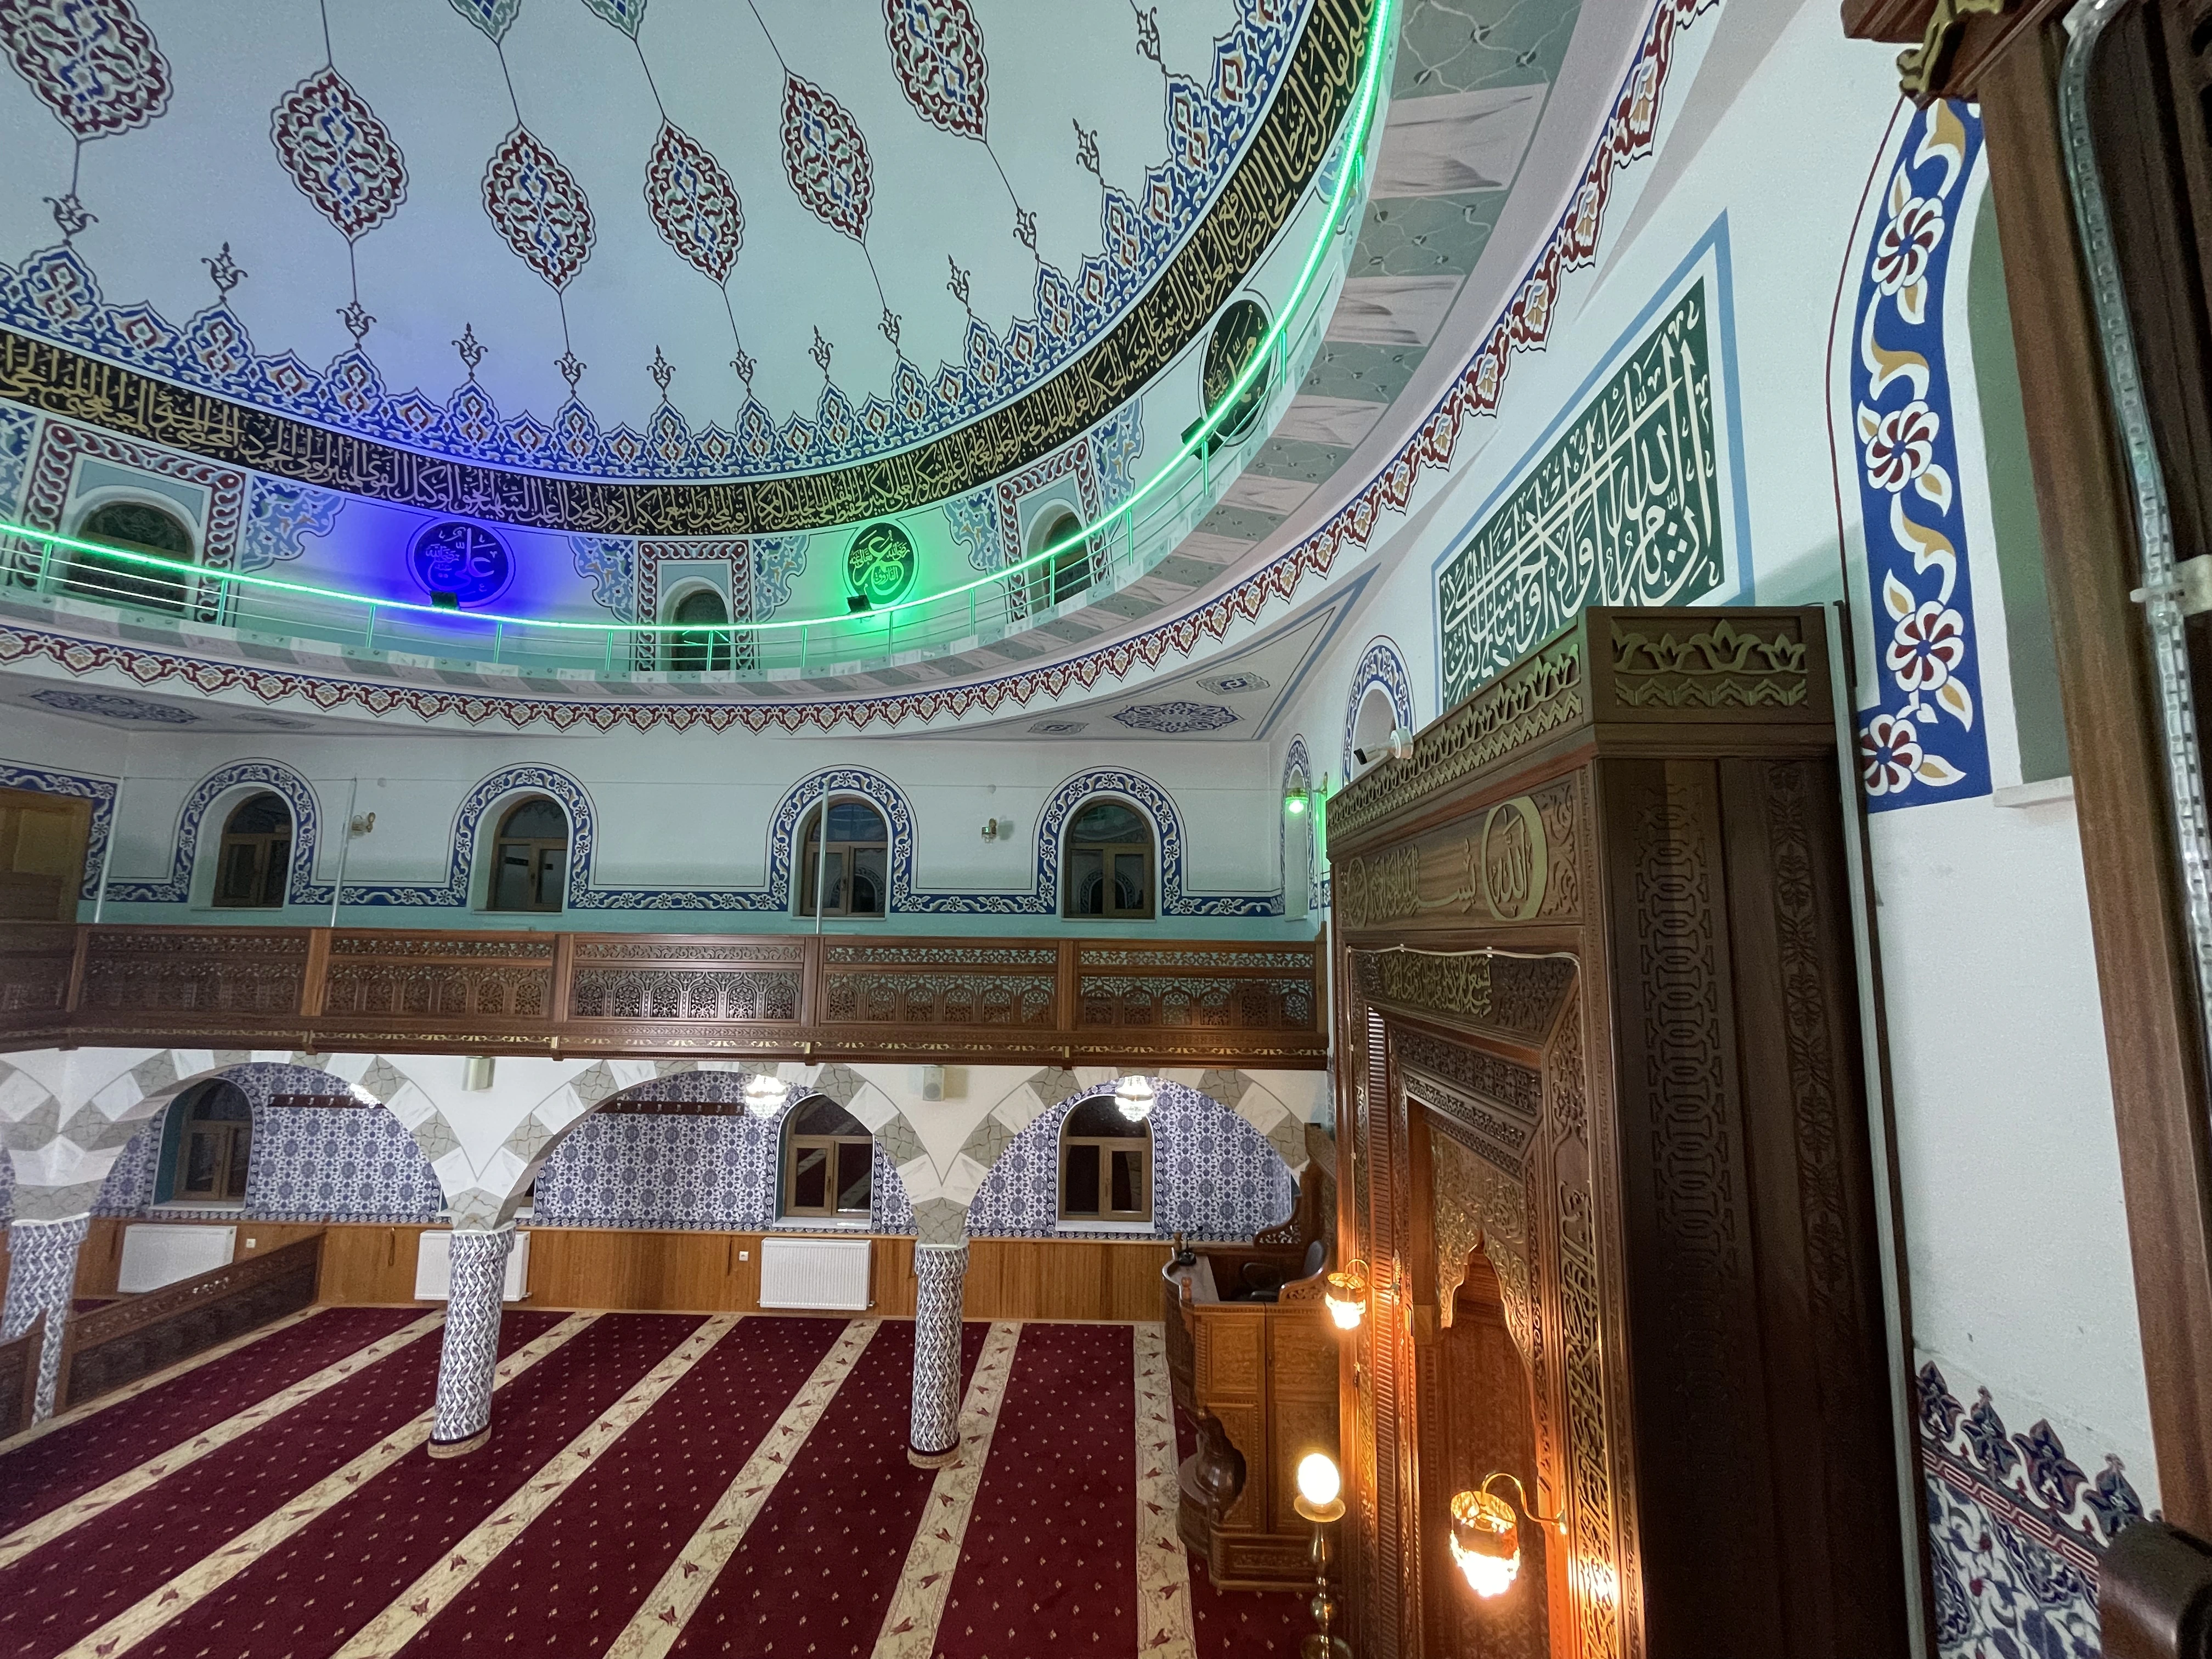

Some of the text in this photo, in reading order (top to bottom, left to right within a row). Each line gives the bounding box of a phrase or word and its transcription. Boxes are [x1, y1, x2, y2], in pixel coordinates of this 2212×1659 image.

[428, 528, 494, 591] علي
[853, 537, 904, 596] عمر
[1488, 814, 1528, 903] الله
